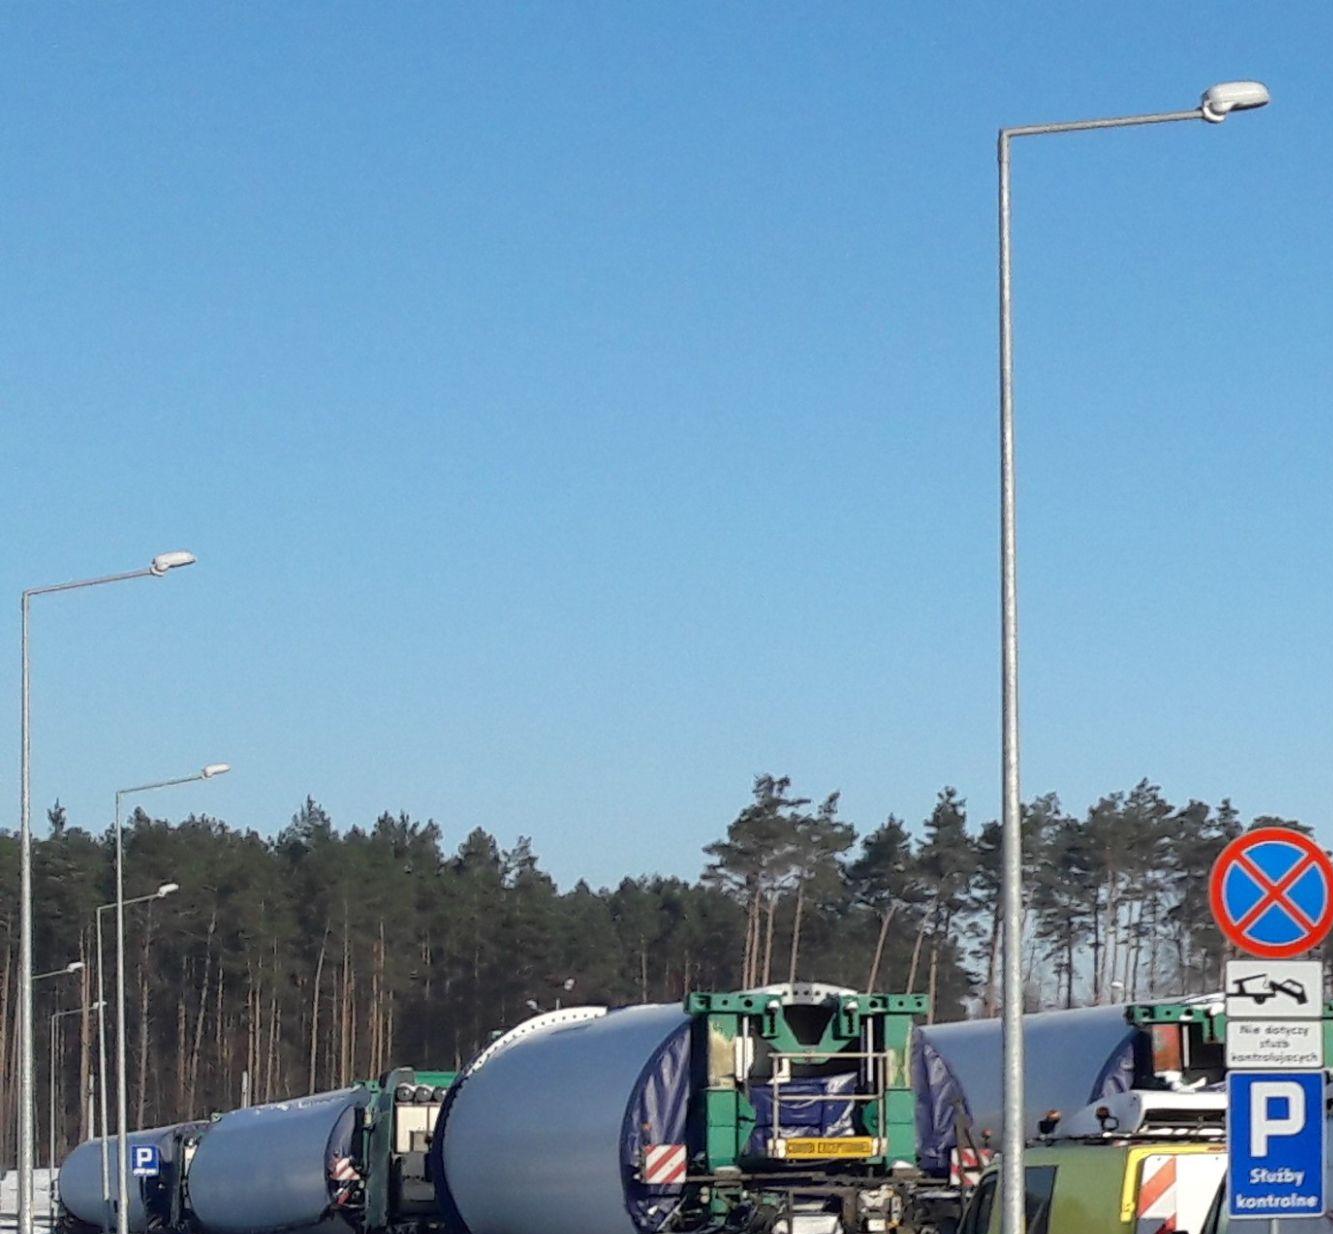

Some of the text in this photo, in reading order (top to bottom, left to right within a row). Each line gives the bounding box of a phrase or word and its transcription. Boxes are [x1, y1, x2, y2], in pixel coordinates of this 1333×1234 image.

[1250, 1081, 1305, 1157] P
[136, 1147, 152, 1167] P
[1249, 1168, 1304, 1187] Służby
[1235, 1193, 1318, 1209] kontrolne
